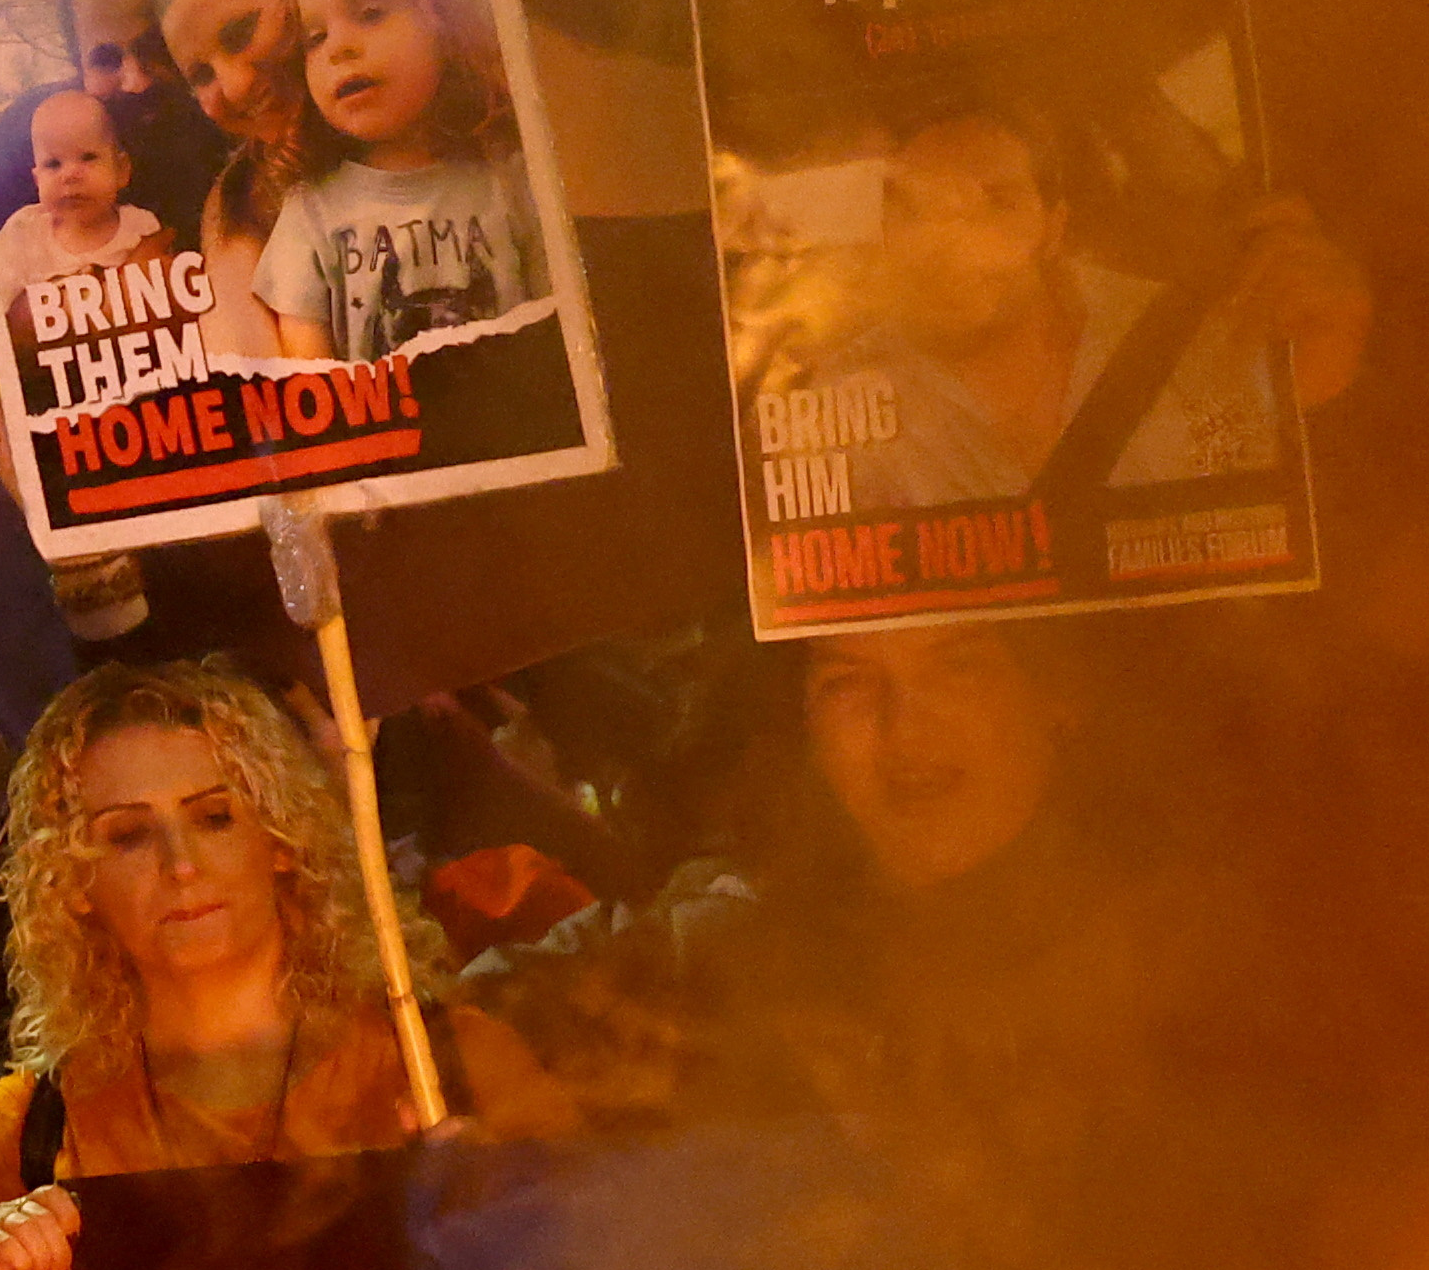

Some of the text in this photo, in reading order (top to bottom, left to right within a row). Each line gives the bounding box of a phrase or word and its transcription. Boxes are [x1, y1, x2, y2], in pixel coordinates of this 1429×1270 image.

[26, 250, 215, 344] BRING
[38, 323, 211, 412] THEM
[55, 354, 420, 477] HOME NOW!
[756, 379, 900, 454] BRING
[764, 452, 851, 522] HIM
[772, 522, 905, 598] HOME
[920, 498, 1054, 580] NOW!
